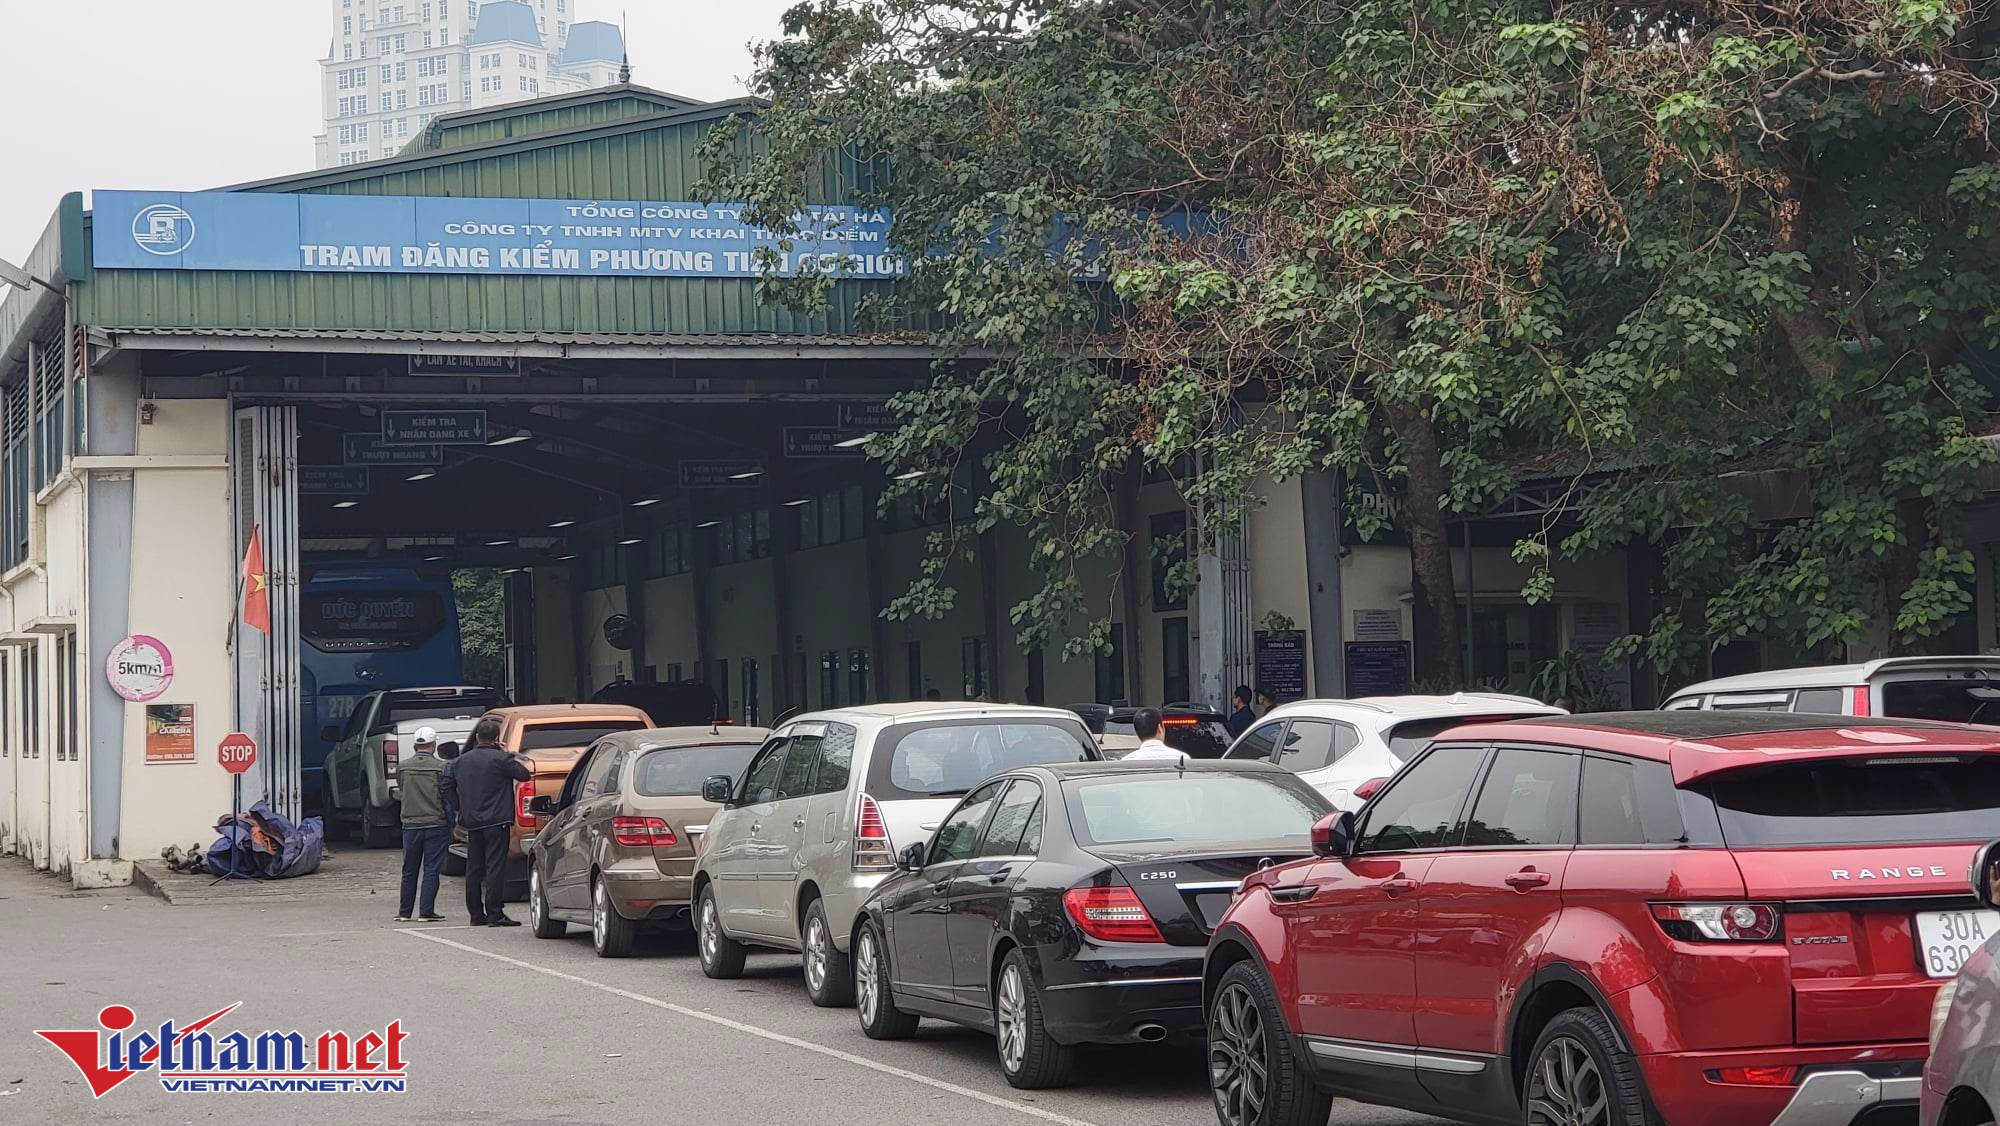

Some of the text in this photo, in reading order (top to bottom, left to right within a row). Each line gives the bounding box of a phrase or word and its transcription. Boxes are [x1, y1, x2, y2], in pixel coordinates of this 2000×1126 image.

[567, 202, 739, 220] TỔNG CÔNG TY
[444, 221, 515, 235] CÔNG
[521, 225, 553, 236] TY
[560, 226, 621, 237] TNHH
[630, 227, 682, 238] MTV
[690, 228, 744, 239] KHAI
[300, 244, 391, 270] TRẠM
[402, 242, 489, 268] ĐĂNG
[500, 240, 579, 269] KIỂM
[591, 248, 713, 273] PHƯƠNG
[723, 251, 789, 277] TIN
[439, 418, 457, 426] TRA
[458, 430, 470, 438] XE
[222, 745, 253, 762] STOP
[1831, 865, 1947, 880] RANGE
[1938, 912, 1986, 942] 30A
